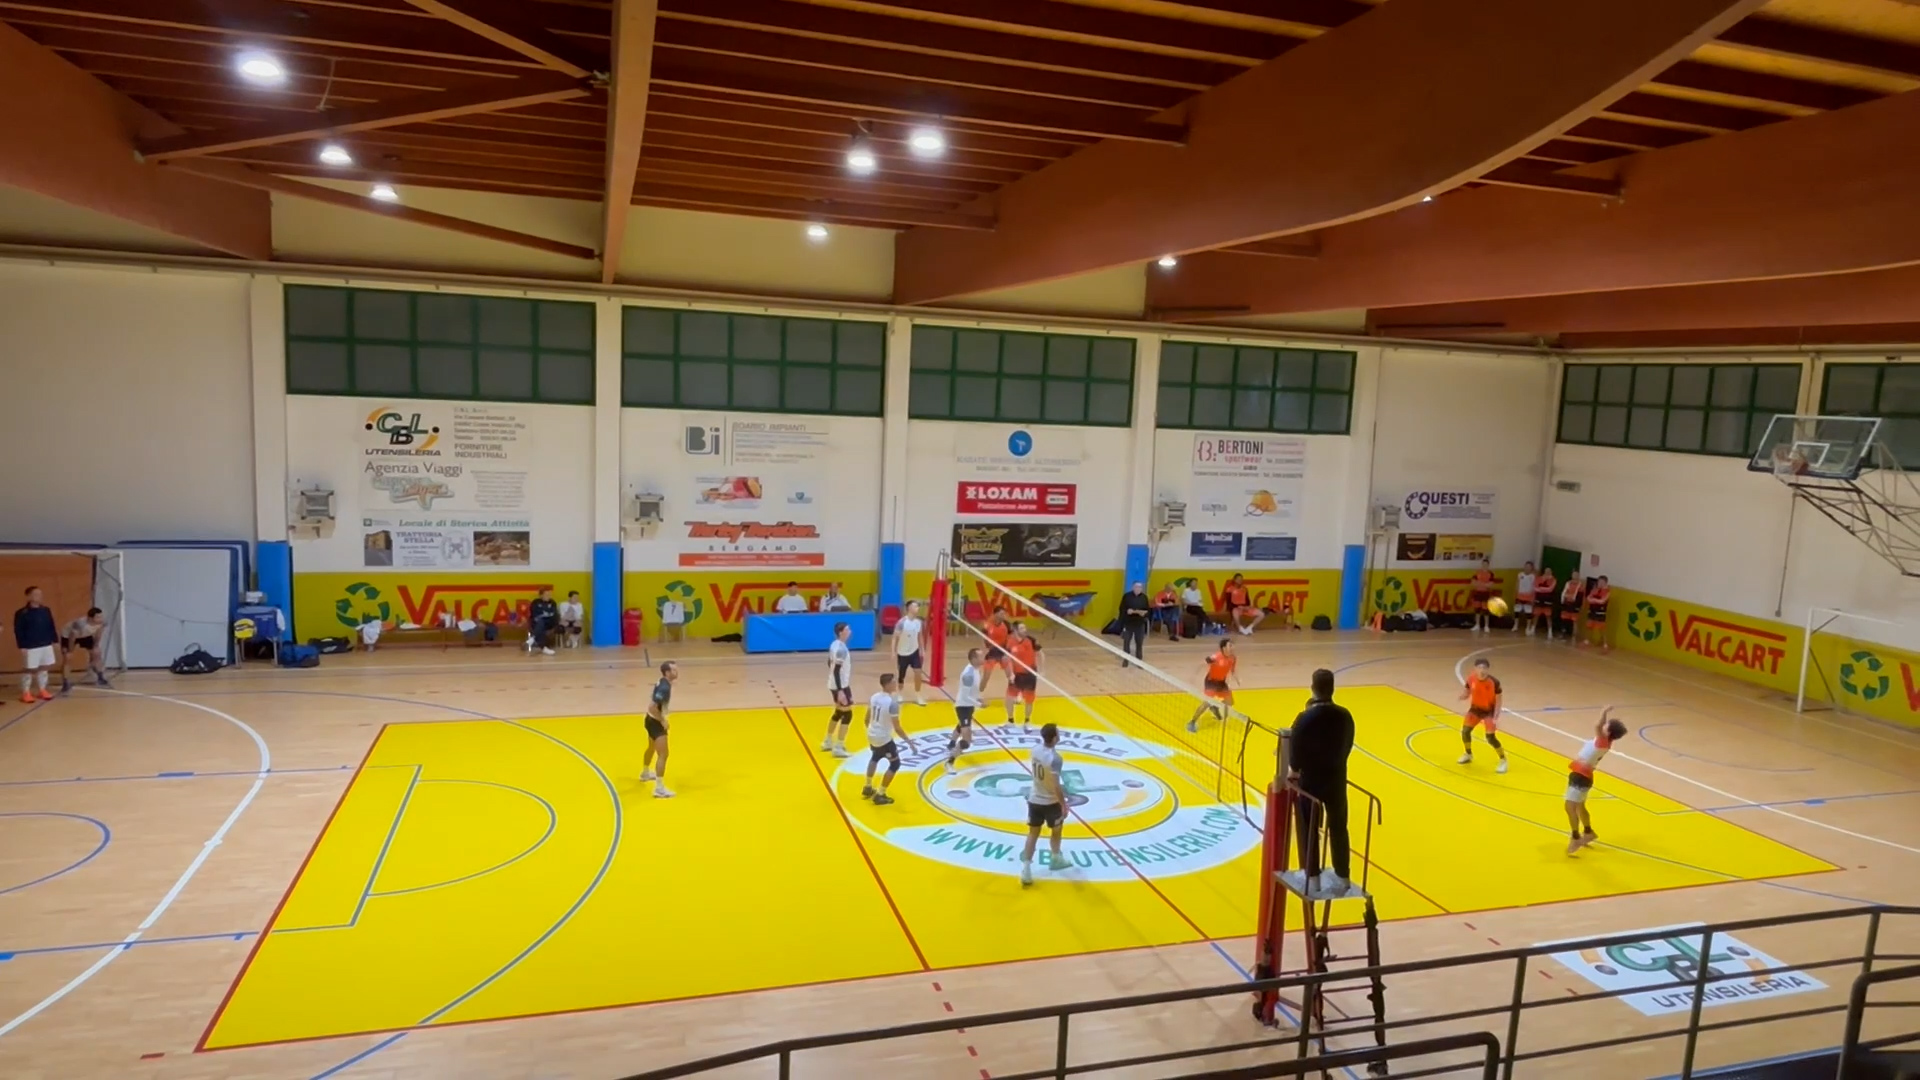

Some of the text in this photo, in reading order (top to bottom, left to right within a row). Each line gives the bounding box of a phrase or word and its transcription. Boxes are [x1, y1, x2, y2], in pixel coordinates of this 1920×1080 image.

[365, 449, 441, 457] UTENSILERIA
[1218, 439, 1264, 454] BERTONI
[364, 461, 463, 477] Agenzia Viaggi
[978, 487, 1038, 500] LOXAM
[1418, 491, 1470, 505] QUESTI
[398, 519, 433, 527] Locale
[436, 519, 447, 527] di
[1668, 609, 1787, 675] VALCART
[1032, 762, 1045, 781] 10
